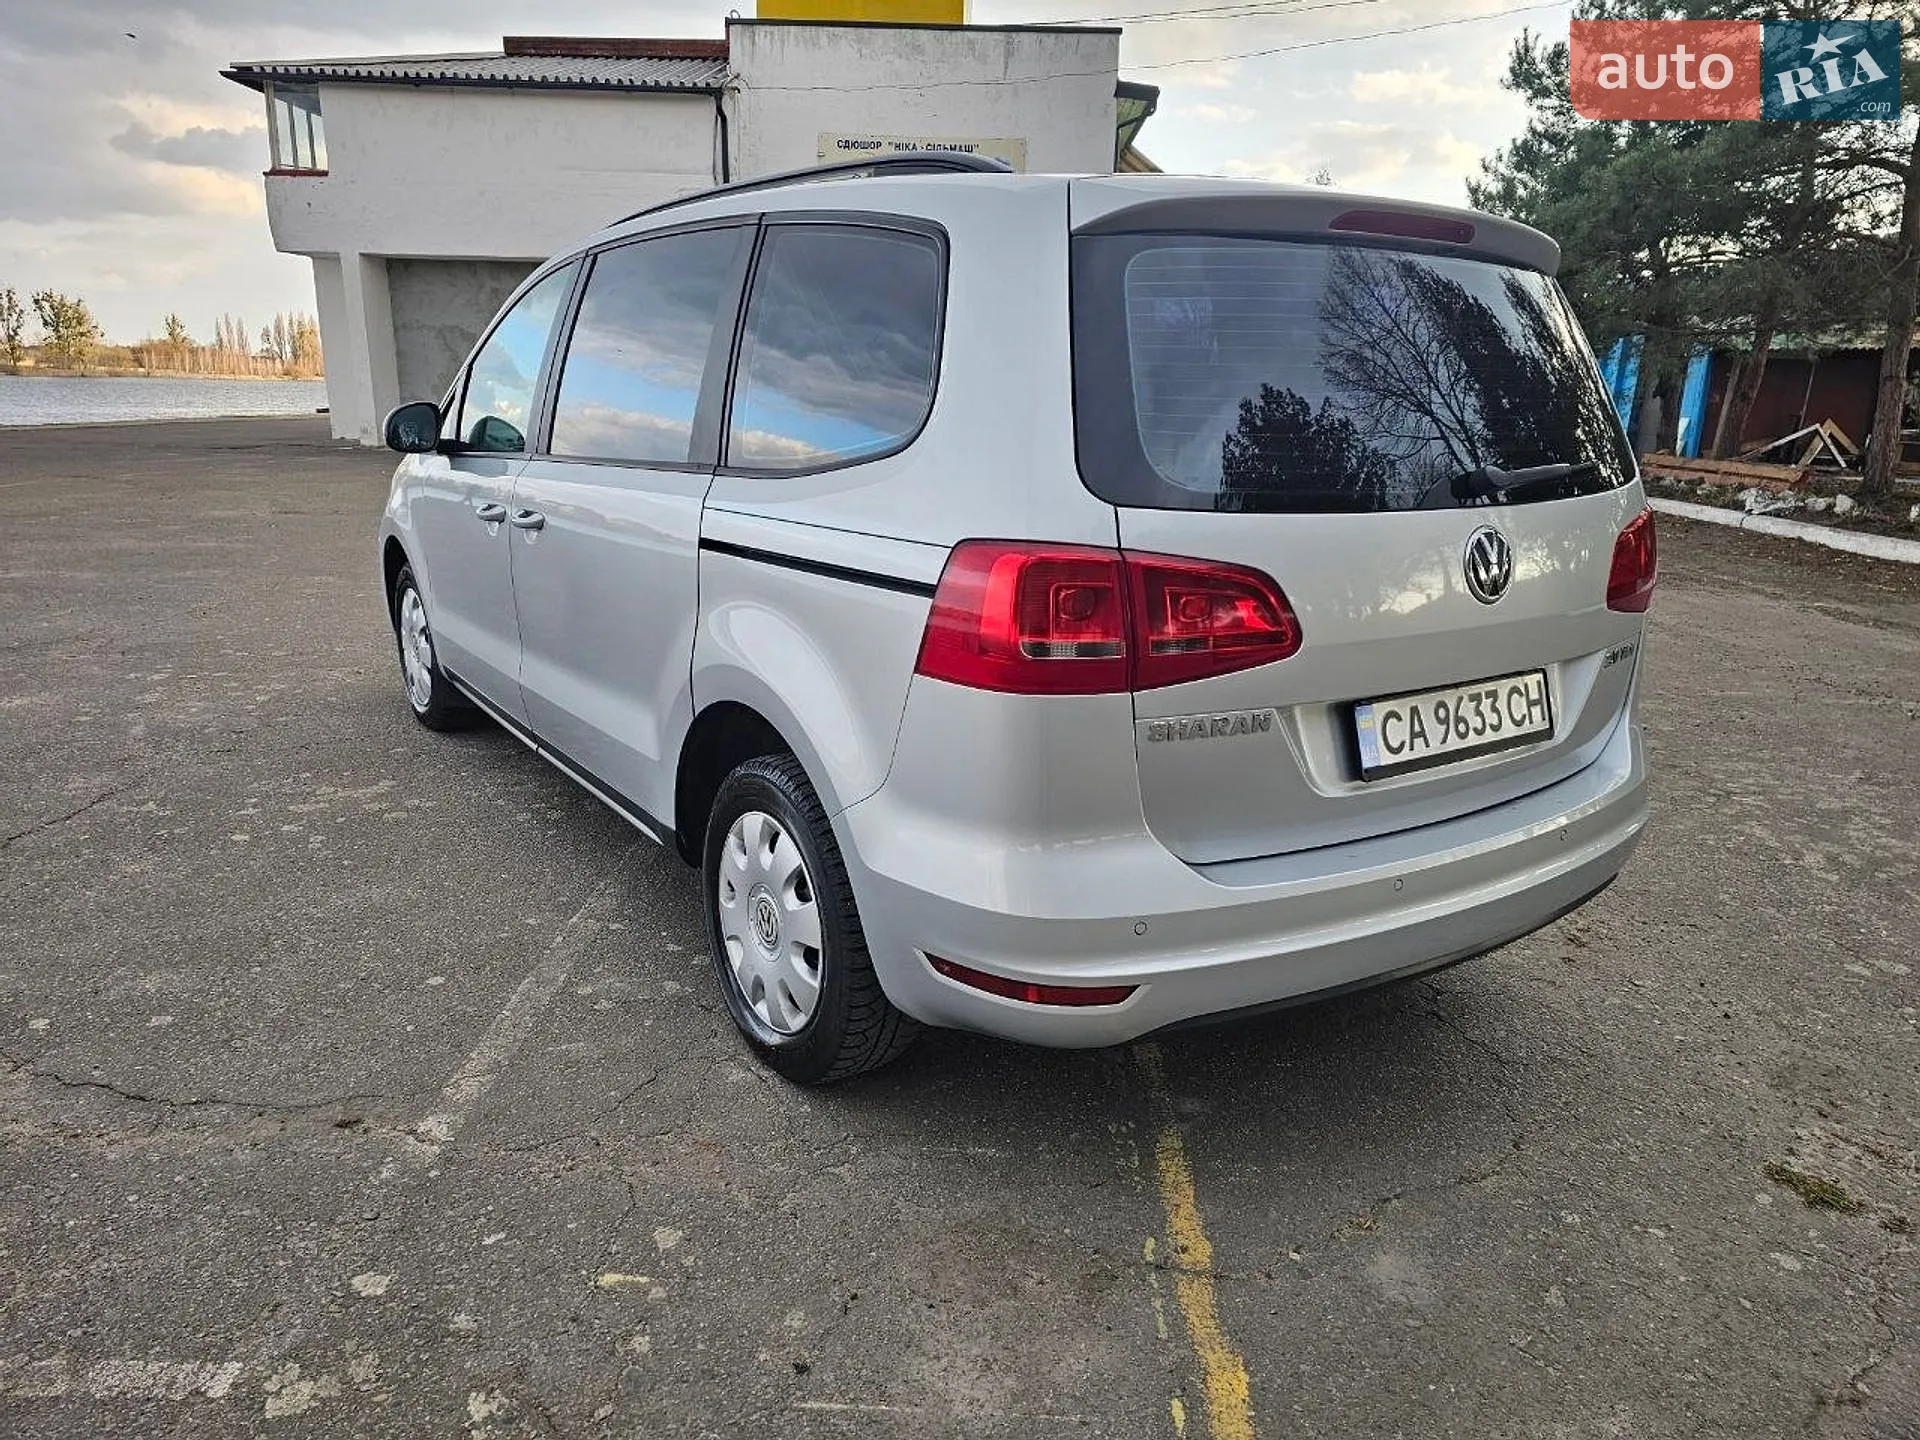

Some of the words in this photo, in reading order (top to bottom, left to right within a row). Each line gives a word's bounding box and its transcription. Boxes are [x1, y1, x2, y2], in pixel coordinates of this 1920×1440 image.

[837, 139, 882, 150] СДЮШОР
[1148, 710, 1272, 742] SHARAN
[1381, 705, 1431, 756] CA
[1433, 689, 1503, 745] 9633
[1507, 679, 1547, 728] CH
